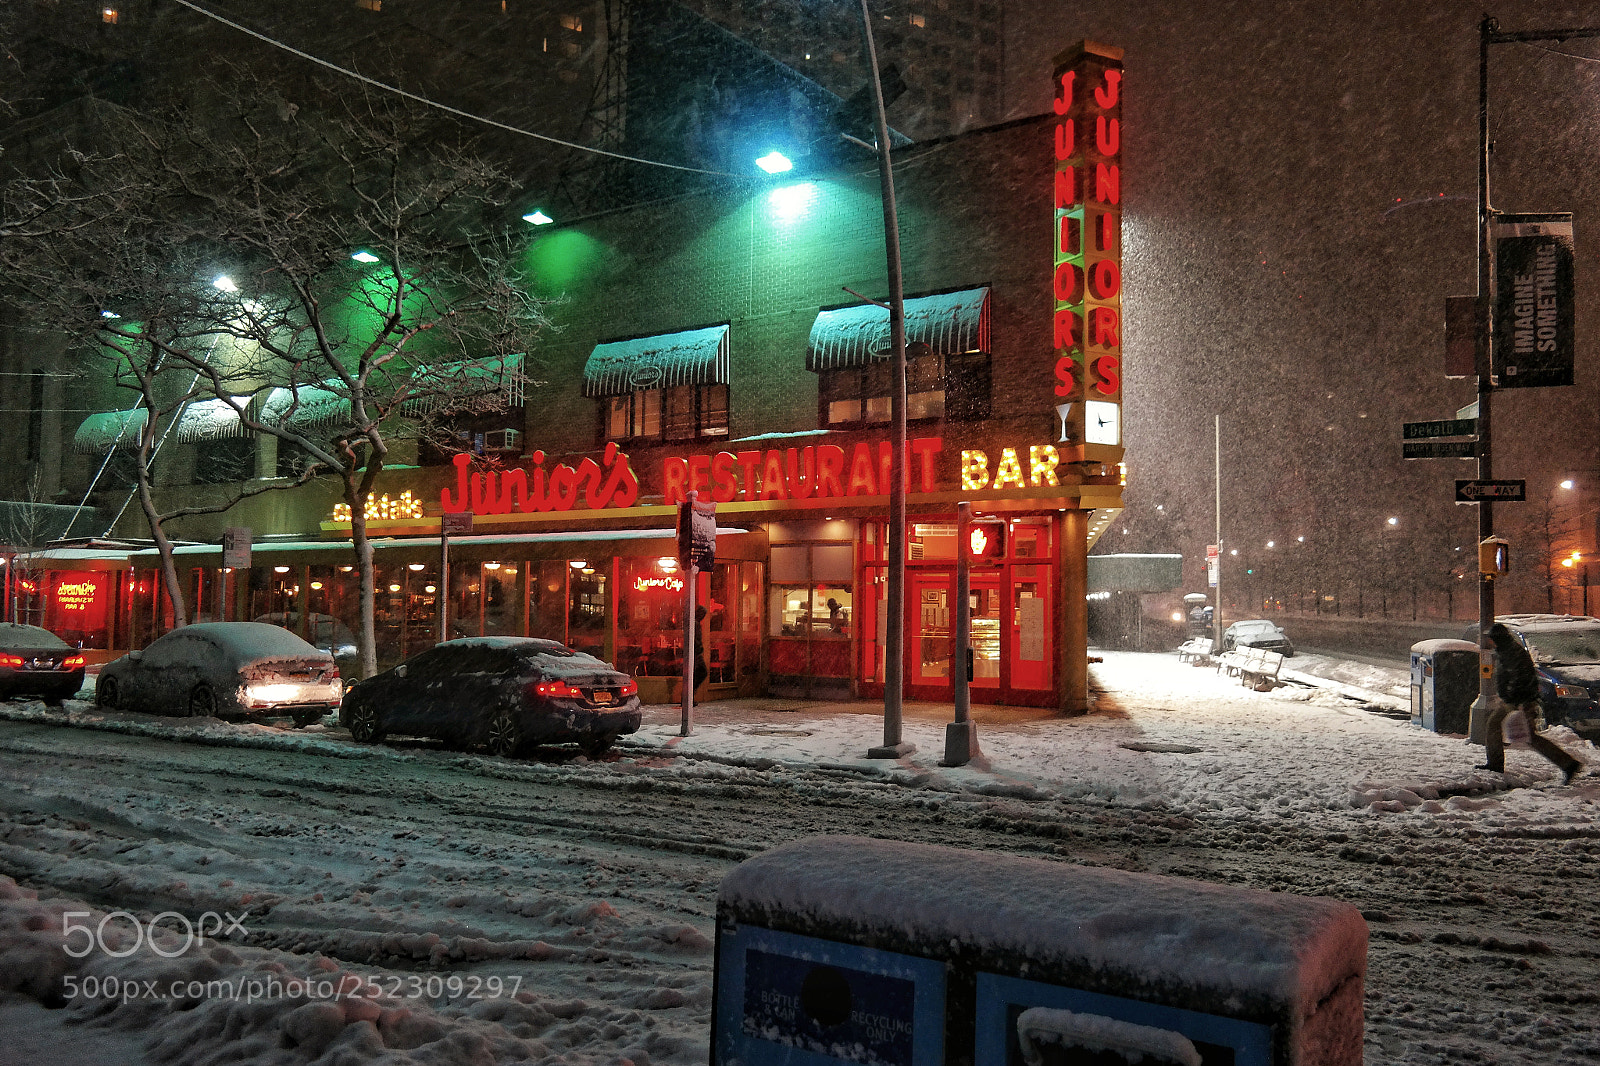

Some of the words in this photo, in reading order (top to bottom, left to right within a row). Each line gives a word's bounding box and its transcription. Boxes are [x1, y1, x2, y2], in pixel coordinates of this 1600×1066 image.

[1054, 71, 1075, 397] JUNIORS
[1095, 69, 1121, 396] JUNIORS
[1514, 274, 1534, 353] IMAGINE
[1537, 243, 1557, 352] SOMETHING
[441, 441, 639, 515] Junior's
[663, 437, 942, 505] RESTAURANT
[961, 444, 1060, 491] BAR
[1466, 486, 1486, 495] ONE
[1494, 486, 1516, 495] WAY
[761, 990, 800, 1010] BOTTLE
[764, 1003, 772, 1015] &
[850, 1010, 913, 1036] RECYCLING
[866, 1024, 897, 1043] ONLY
